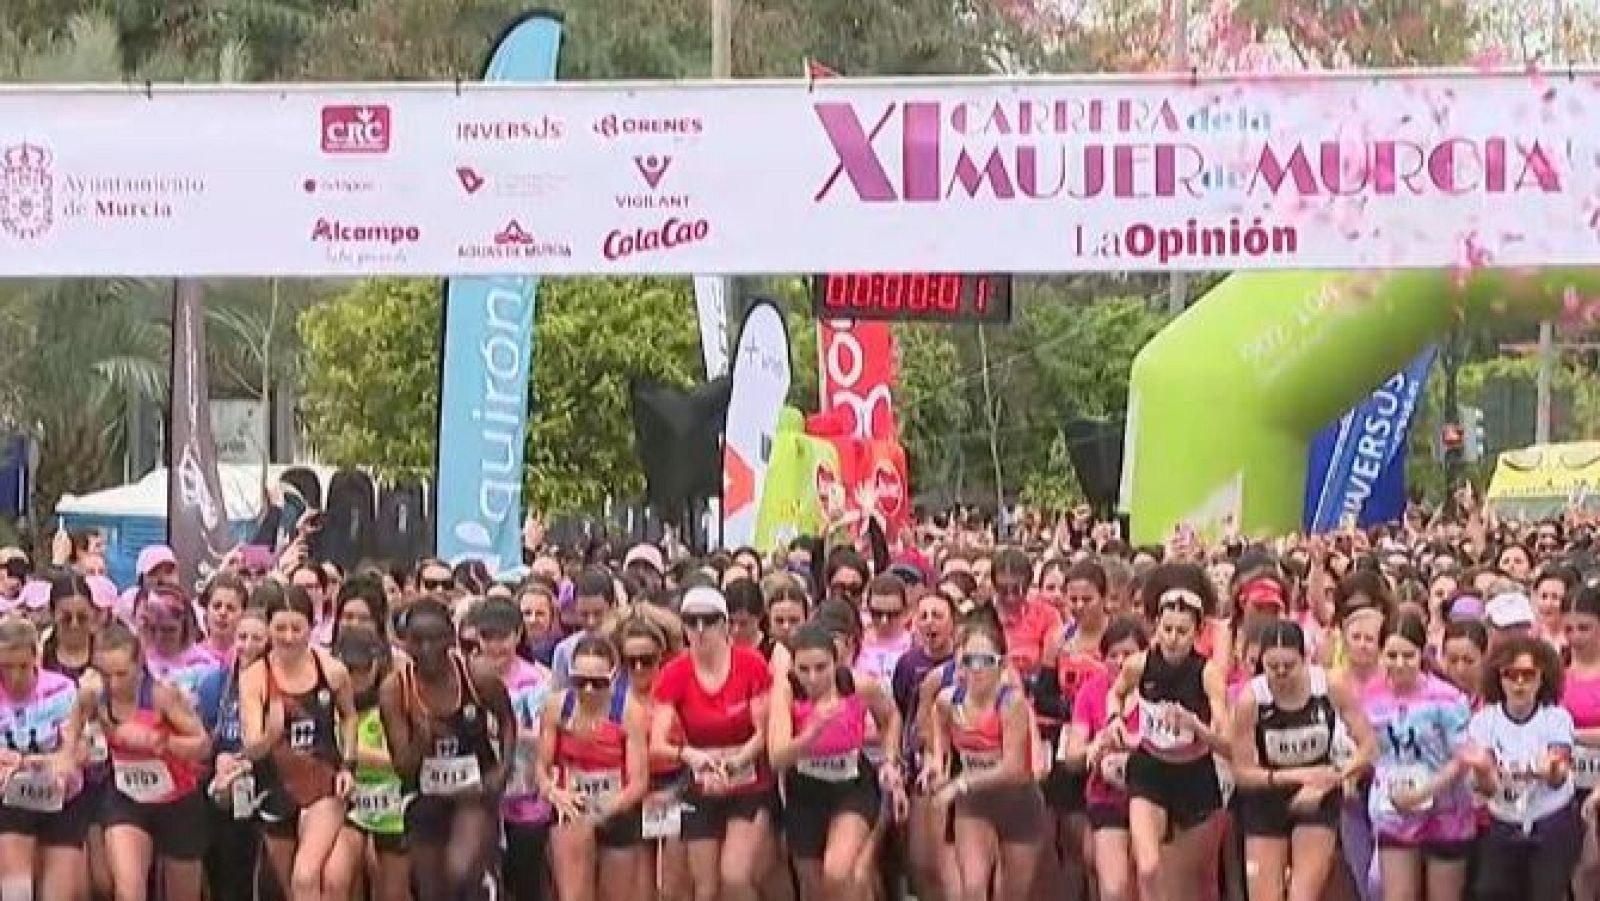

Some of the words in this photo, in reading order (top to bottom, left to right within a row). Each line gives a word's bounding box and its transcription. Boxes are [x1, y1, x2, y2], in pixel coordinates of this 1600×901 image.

[950, 99, 1181, 135] CARRERA
[814, 102, 942, 203] XI
[945, 143, 1205, 201] MUJER
[1246, 136, 1562, 199] MURCIA
[64, 174, 205, 198] Ayuntamiento
[615, 194, 689, 209] VIGILANT
[63, 199, 88, 217] de
[95, 199, 173, 218] Murcia
[311, 217, 420, 245] Alcampo
[603, 216, 708, 261] ColaCao
